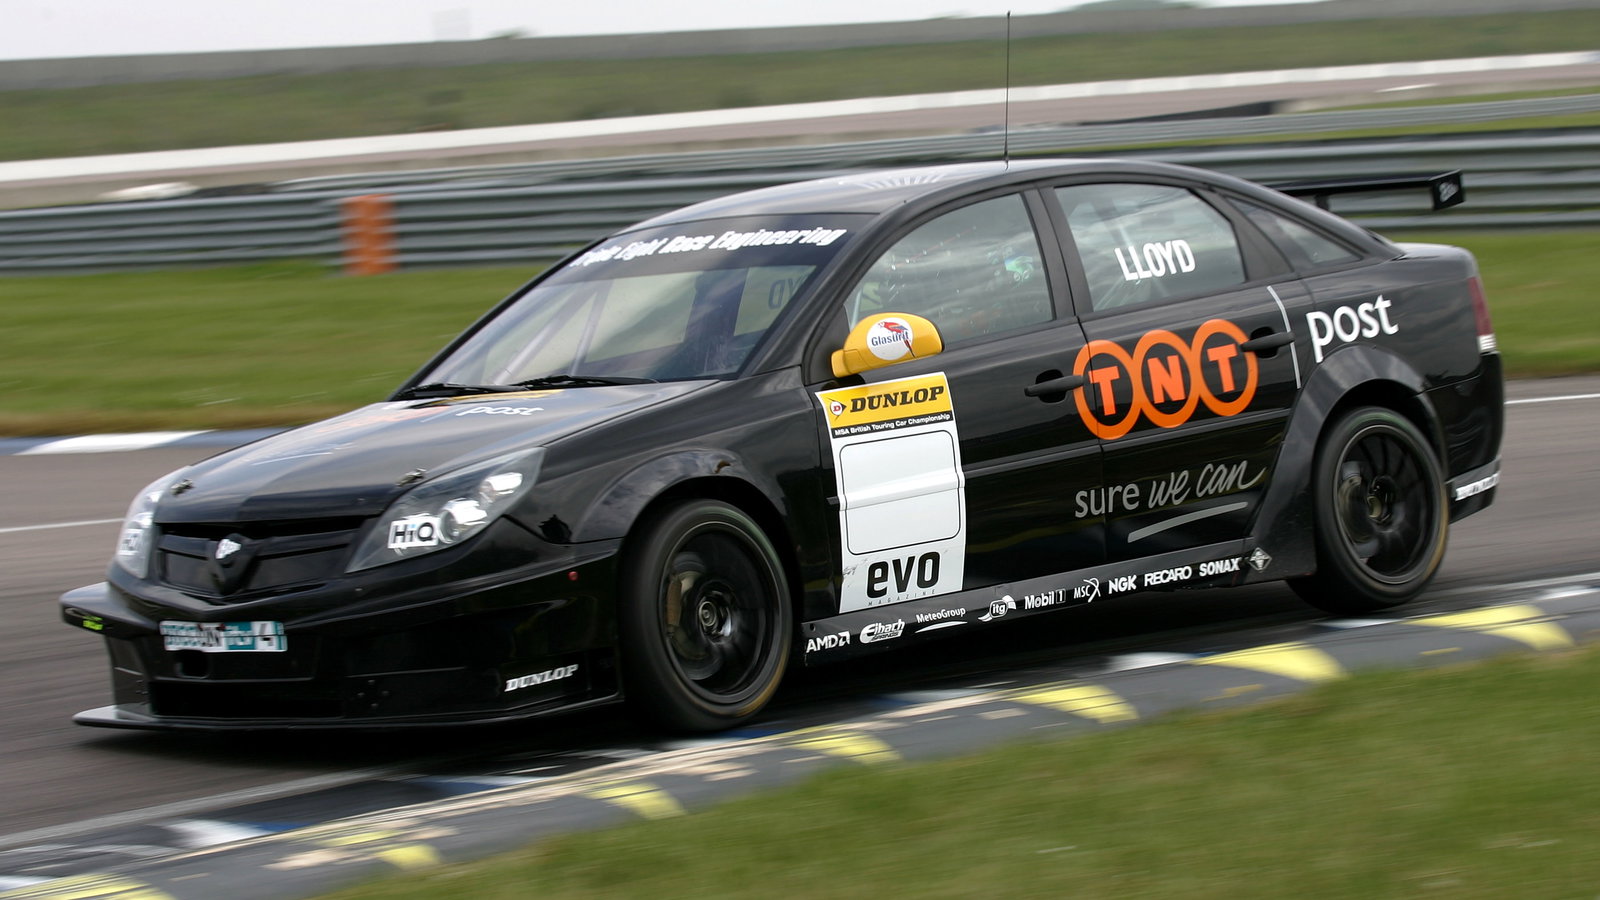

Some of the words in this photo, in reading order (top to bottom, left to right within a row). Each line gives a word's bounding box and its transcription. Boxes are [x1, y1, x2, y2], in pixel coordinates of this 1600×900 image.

[658, 234, 715, 254] Race
[709, 227, 847, 250] Engineering
[1115, 239, 1196, 281] LLOYD
[1306, 295, 1399, 363] post
[1088, 343, 1238, 416] TNT
[850, 386, 944, 412] DUNLOP
[850, 424, 871, 433] British
[872, 419, 895, 430] Touring
[895, 419, 908, 427] Car
[908, 413, 951, 425] Championship
[1075, 483, 1140, 518] sure
[1148, 470, 1192, 508] we
[1196, 460, 1267, 497] can
[393, 522, 435, 543] HiQ
[867, 552, 940, 598] evo
[1144, 565, 1193, 587] RECARO
[1199, 557, 1242, 577] SONAX
[1108, 575, 1138, 594] NGK
[868, 589, 936, 606] MAGAZINE
[1024, 591, 1055, 609] Mobil
[916, 607, 966, 623] MeteoGroup
[993, 604, 1006, 615] itg
[860, 619, 905, 643] Eibach
[806, 635, 838, 653] AMD
[504, 664, 579, 692] DUNLOP
